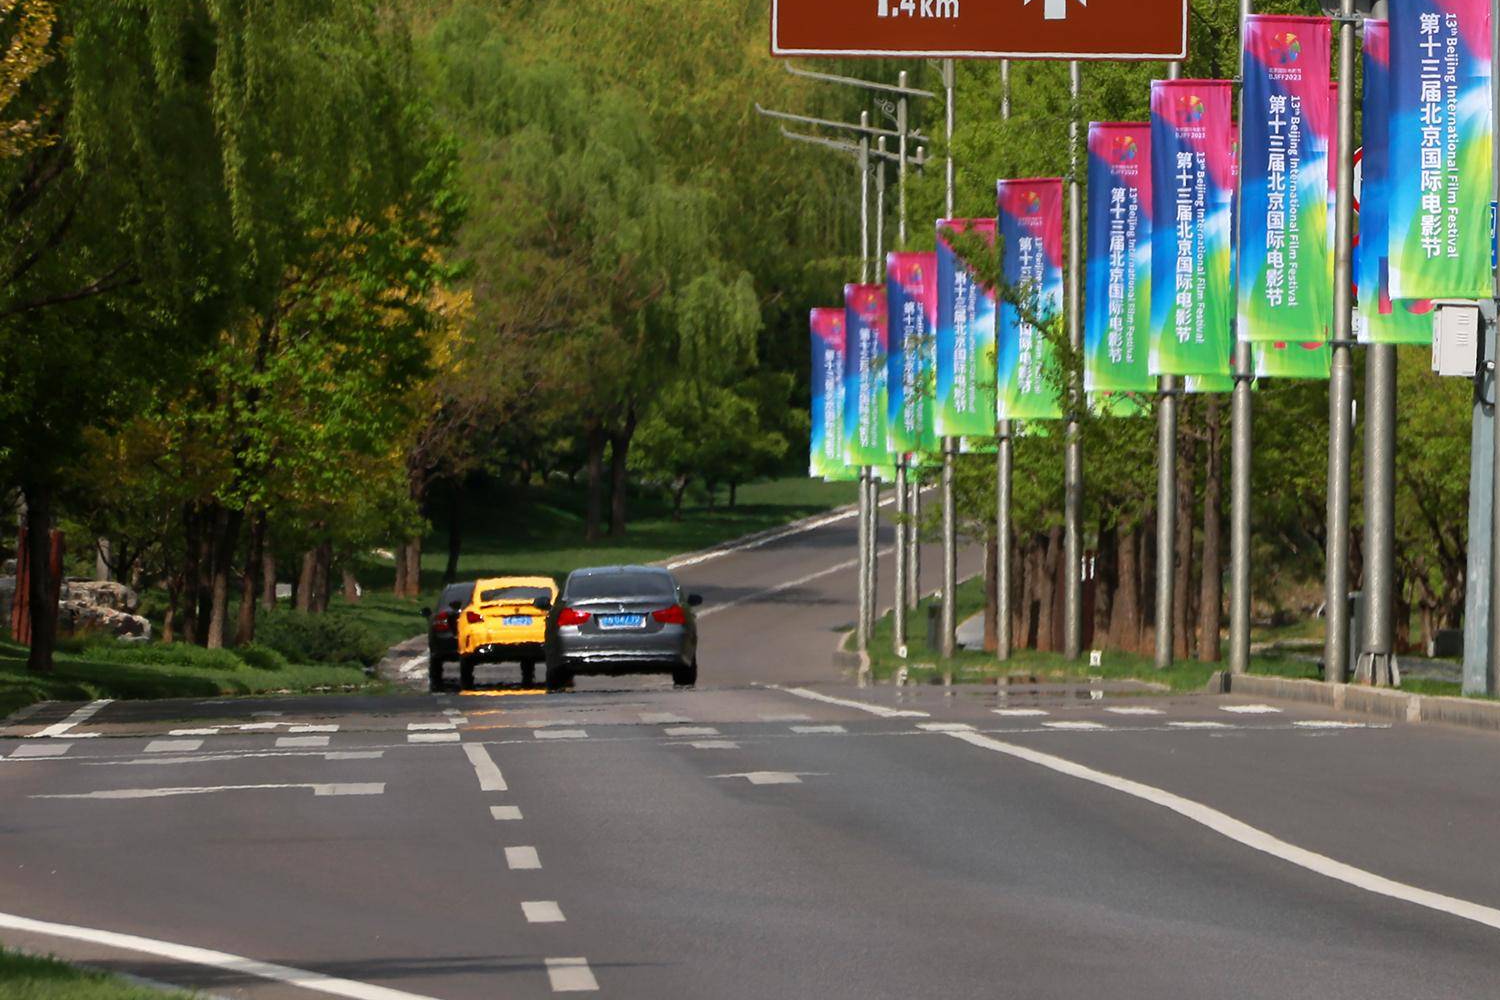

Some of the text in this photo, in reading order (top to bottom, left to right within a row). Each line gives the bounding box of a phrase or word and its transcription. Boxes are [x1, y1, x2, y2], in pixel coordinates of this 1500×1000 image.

[1444, 37, 1459, 82] Beijing
[1419, 12, 1443, 259] 第十三届北京国际电影节
[1446, 86, 1459, 172] International
[1446, 174, 1459, 202] Film
[1446, 203, 1459, 258] Festival
